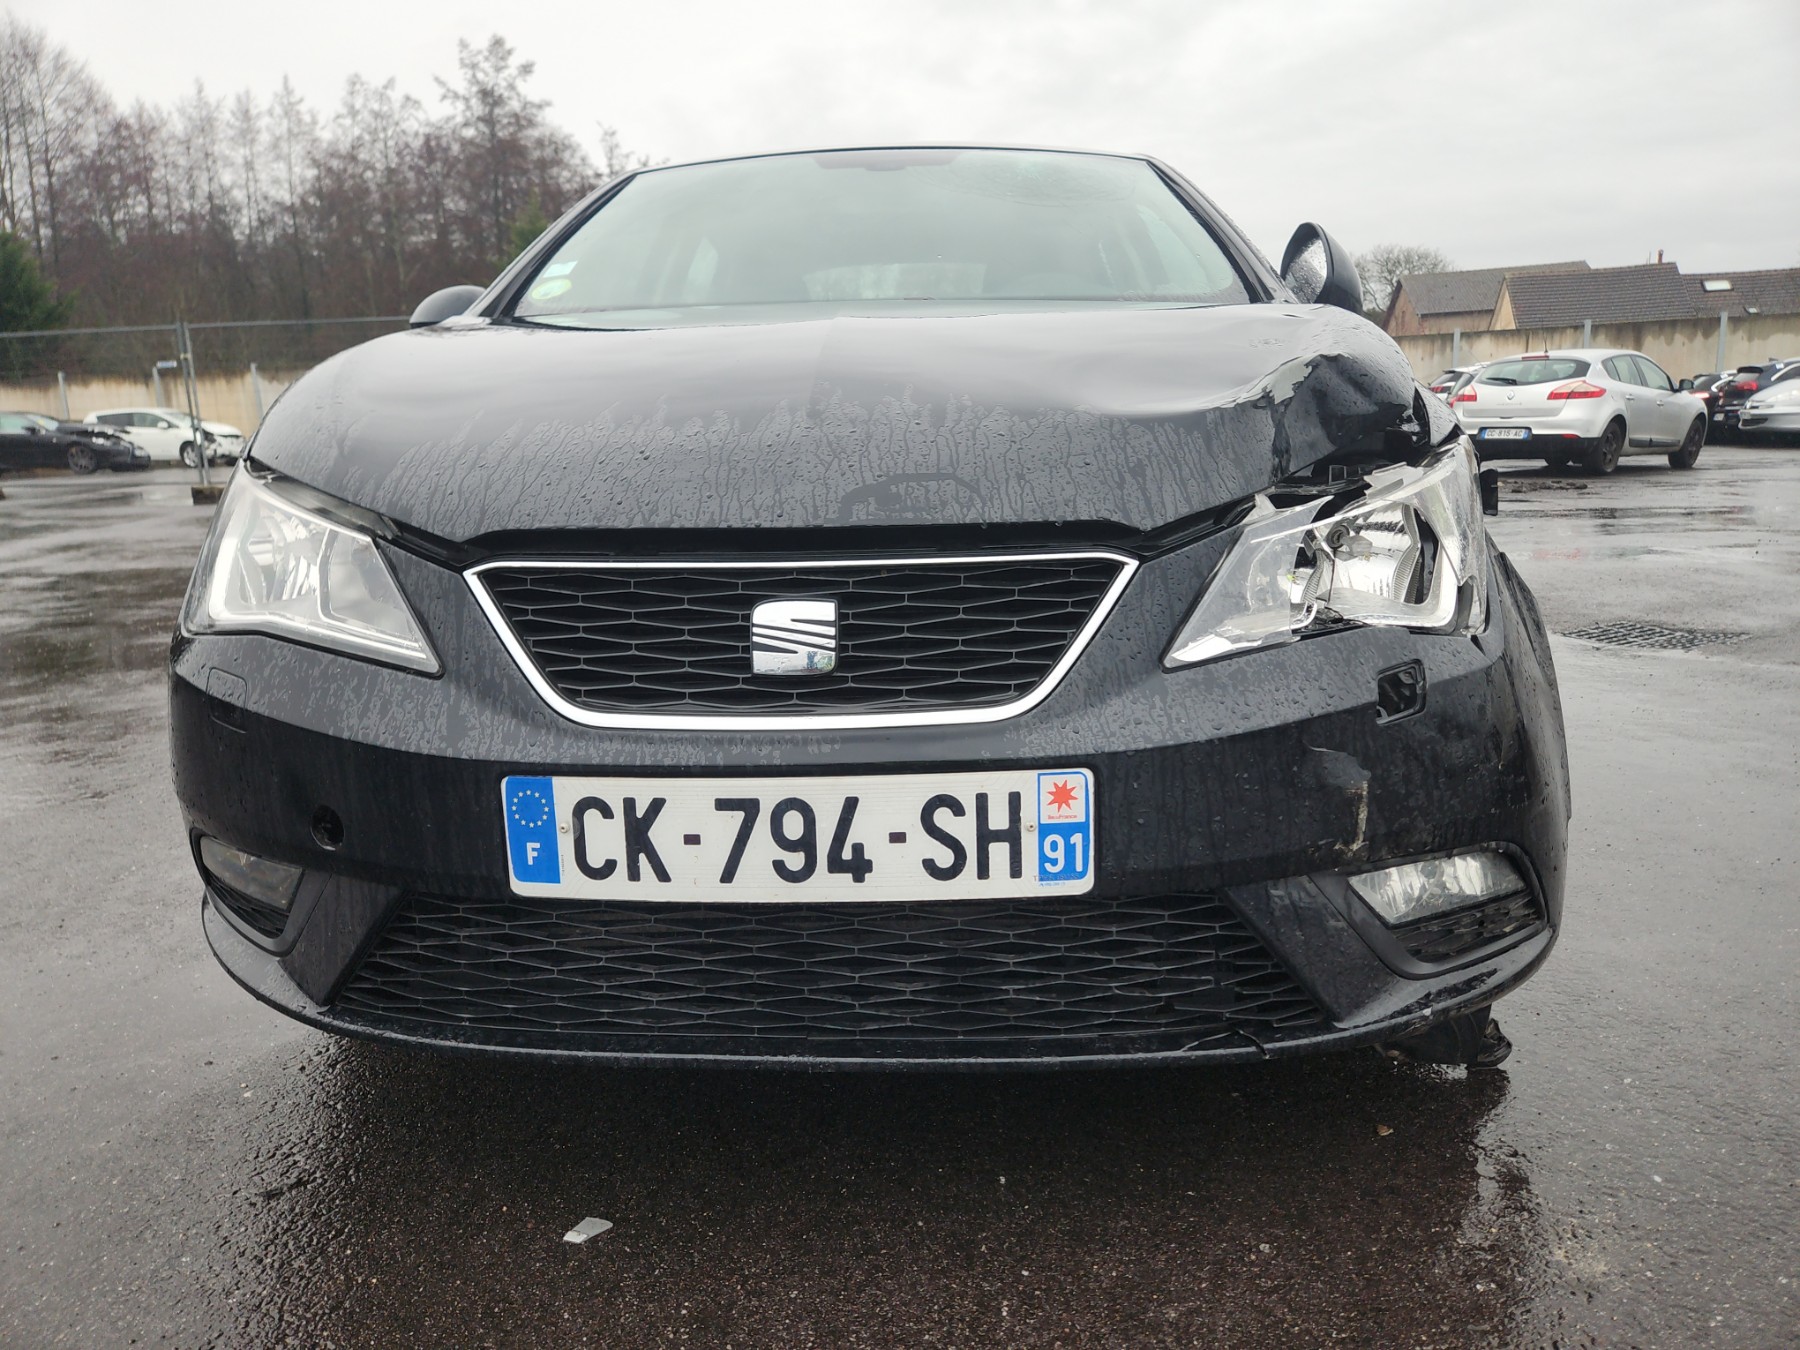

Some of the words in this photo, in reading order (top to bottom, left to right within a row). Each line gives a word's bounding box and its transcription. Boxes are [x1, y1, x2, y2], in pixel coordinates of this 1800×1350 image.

[527, 842, 540, 865] F
[572, 792, 1022, 883] CK-794-SH
[1043, 833, 1083, 873] 91
